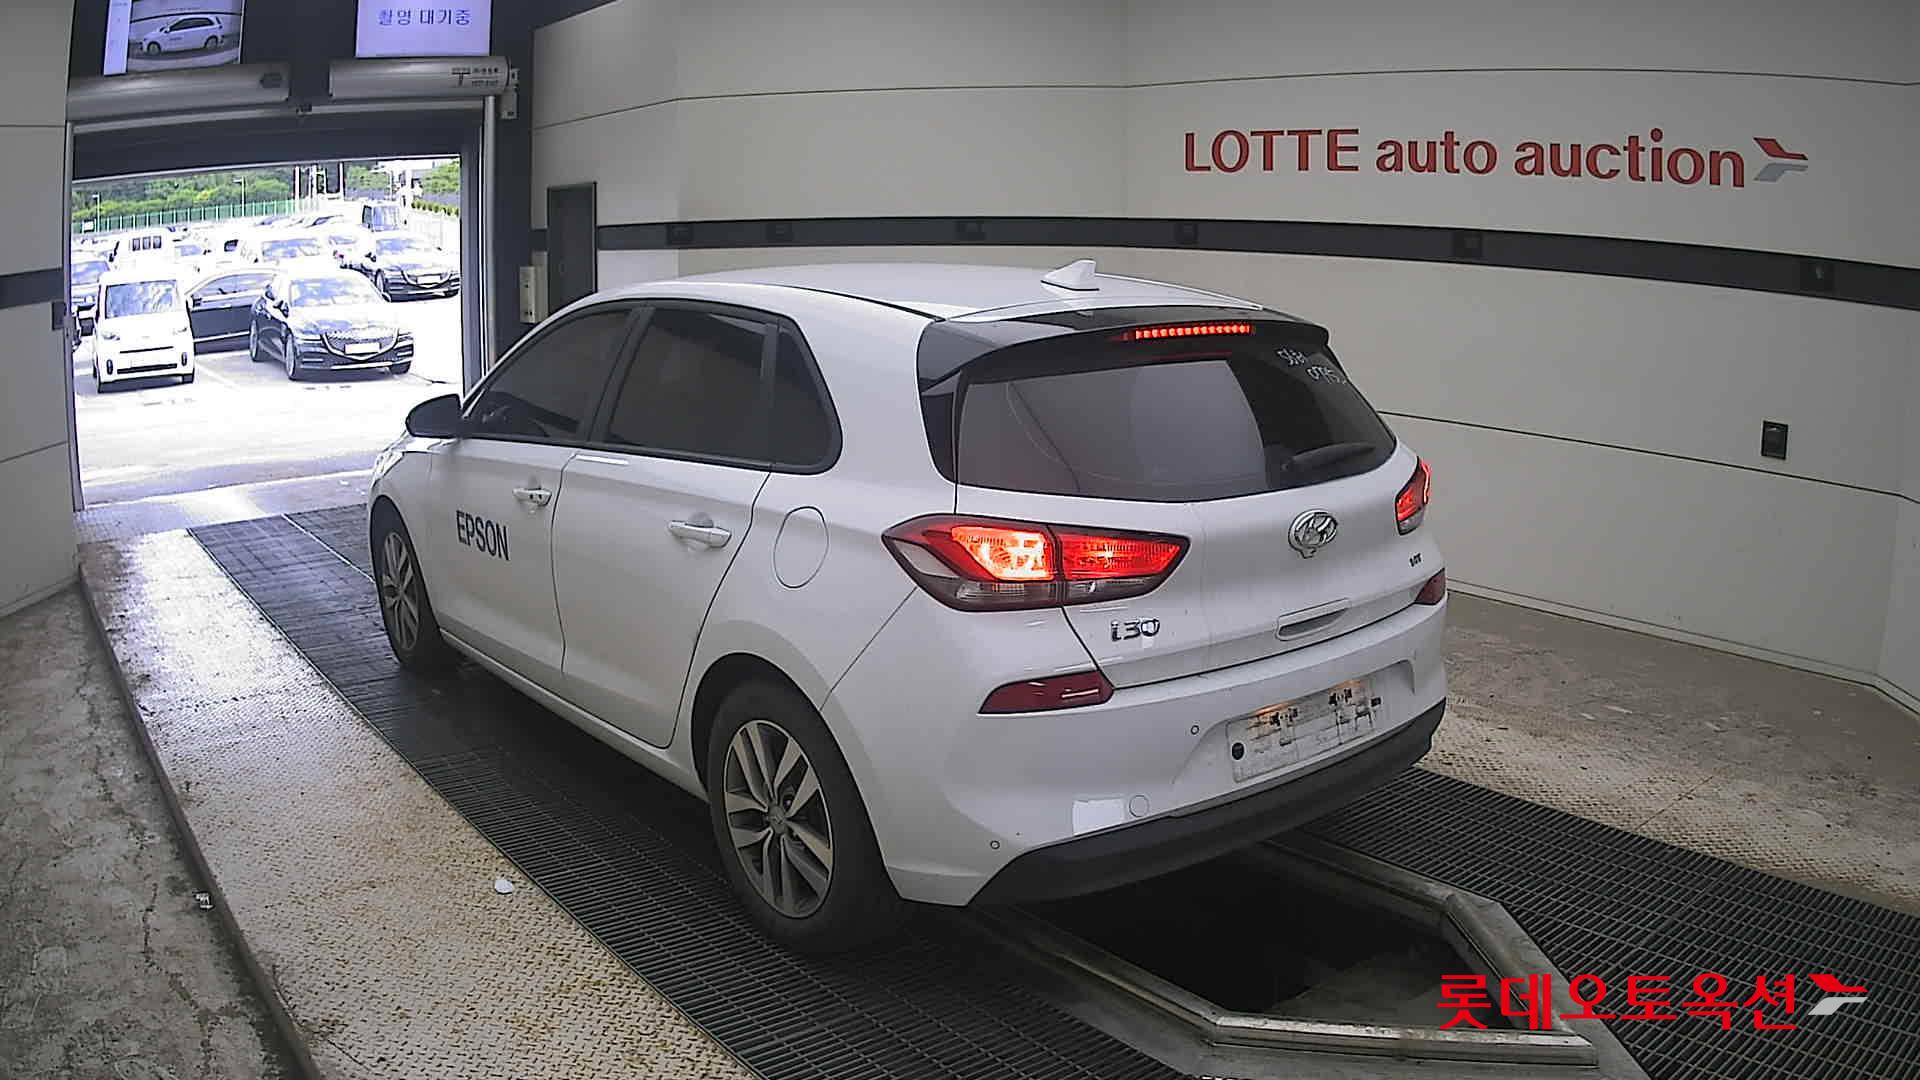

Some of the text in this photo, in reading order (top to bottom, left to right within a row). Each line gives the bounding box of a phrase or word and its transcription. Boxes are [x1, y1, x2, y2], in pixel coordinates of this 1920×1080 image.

[1184, 127, 1745, 188] LOTTE auto auction
[456, 510, 509, 561] EPSON
[1111, 619, 1160, 641] i30
